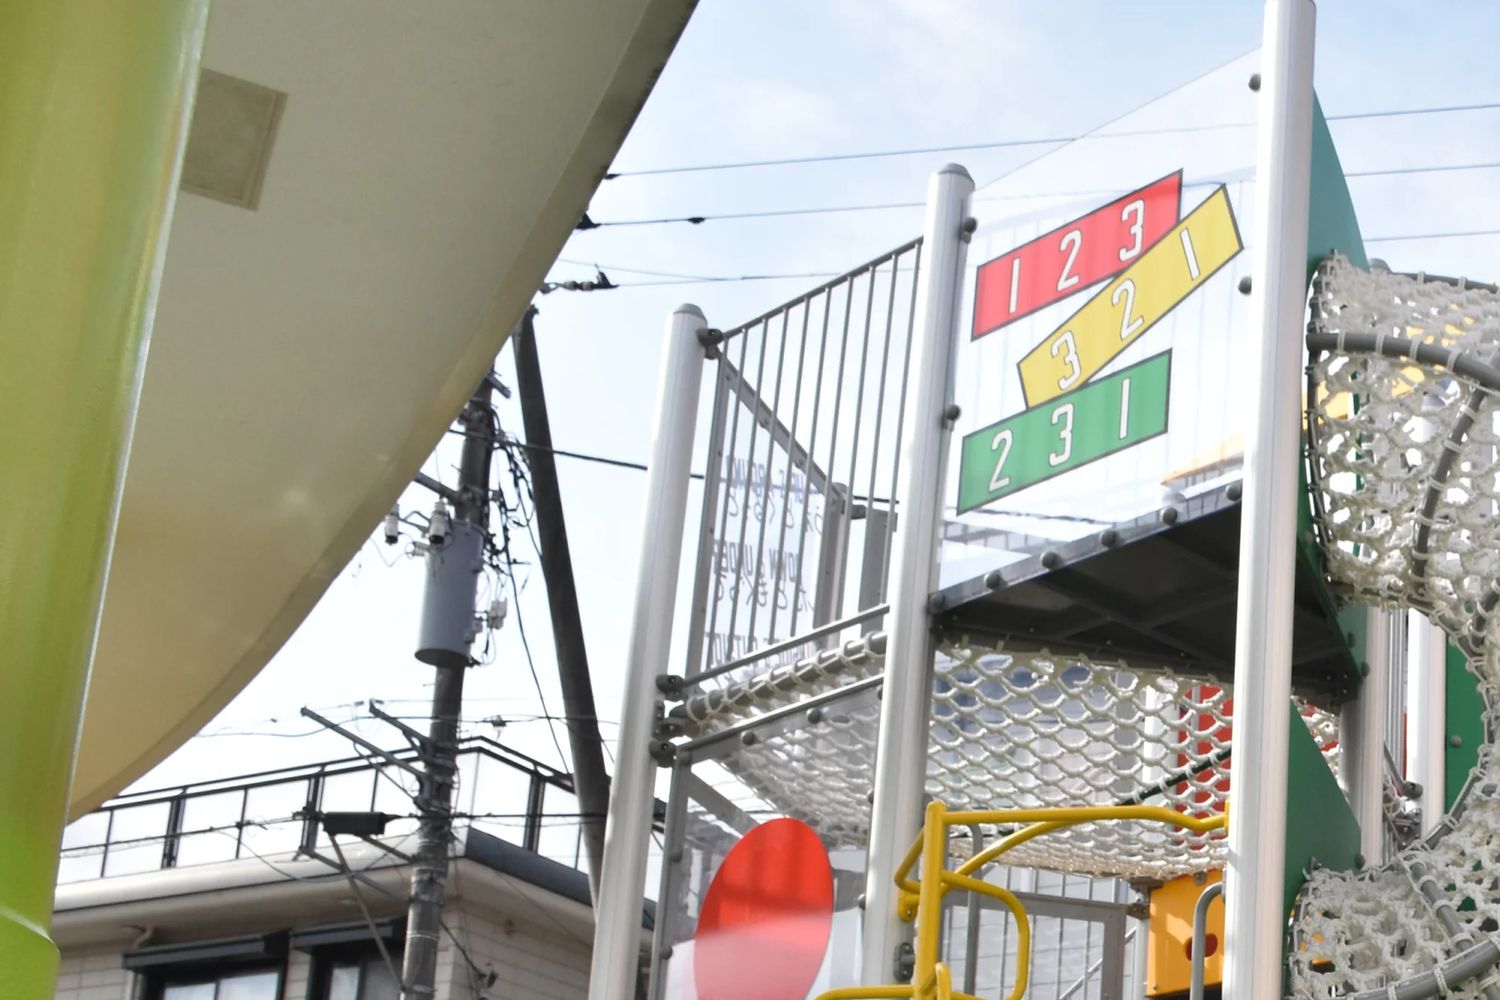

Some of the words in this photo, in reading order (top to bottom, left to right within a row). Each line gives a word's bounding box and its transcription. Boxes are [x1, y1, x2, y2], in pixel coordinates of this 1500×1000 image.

[1056, 229, 1082, 292] 2
[1119, 198, 1145, 262] 3
[1051, 329, 1081, 391] 3
[1111, 278, 1145, 340] 2
[988, 428, 1014, 493] 2
[1048, 402, 1075, 467] 3
